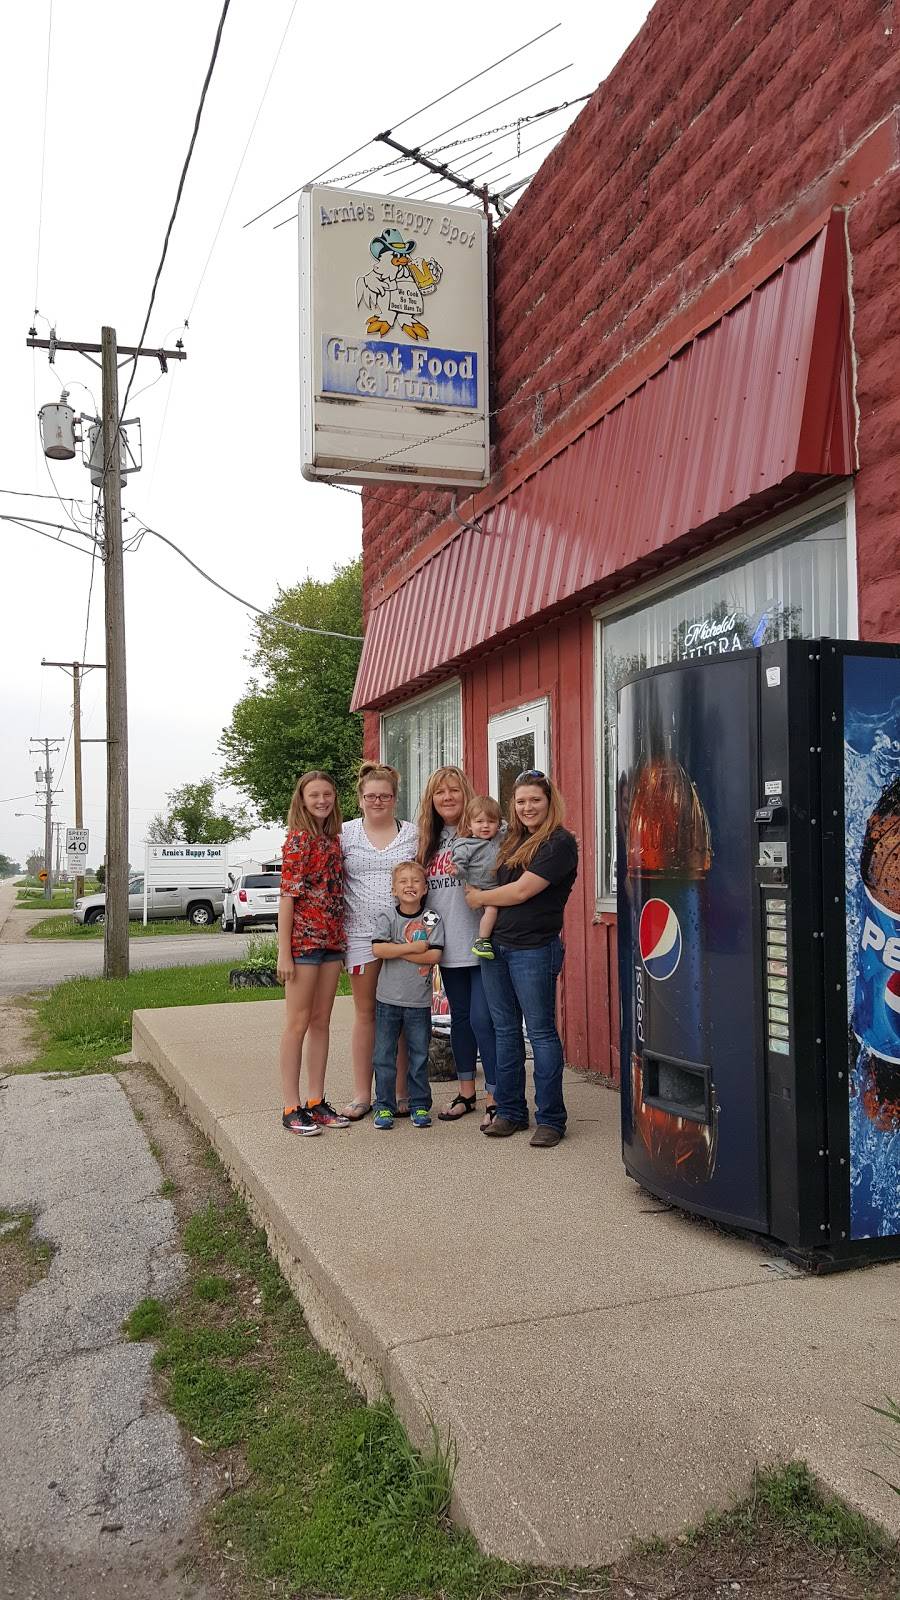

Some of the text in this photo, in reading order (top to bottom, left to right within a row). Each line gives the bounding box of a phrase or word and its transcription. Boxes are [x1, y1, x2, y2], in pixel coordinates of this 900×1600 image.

[320, 202, 477, 249] Arnie's Happy Spot
[326, 337, 474, 379] Great Food
[355, 366, 441, 401] & Fun
[684, 612, 737, 647] Michelob
[68, 842, 86, 851] 40
[185, 849, 206, 858] Happy
[207, 849, 221, 857] Spot
[635, 966, 645, 1042] pepsi
